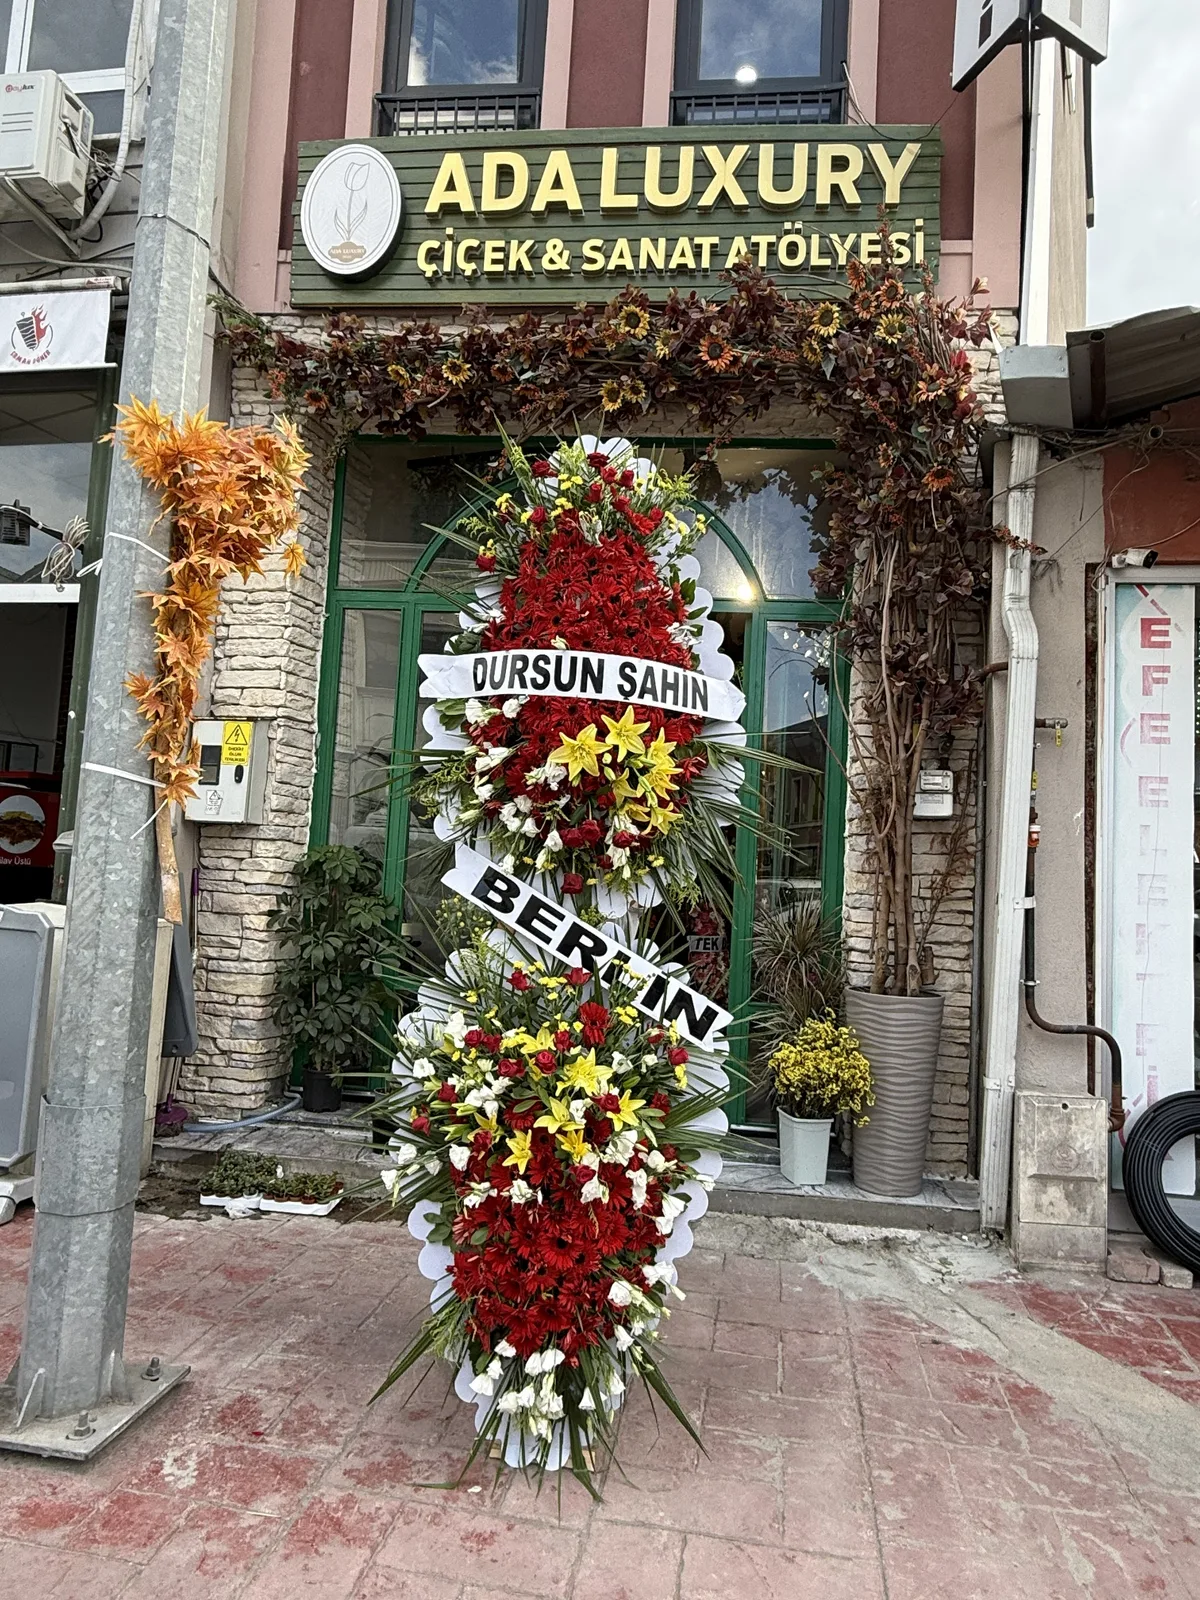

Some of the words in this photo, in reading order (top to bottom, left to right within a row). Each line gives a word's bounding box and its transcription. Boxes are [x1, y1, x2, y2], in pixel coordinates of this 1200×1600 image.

[424, 149, 584, 216] ADA
[600, 143, 921, 214] LUXURY
[417, 227, 535, 278] ÇİÇEK
[541, 238, 571, 270] &
[581, 236, 720, 271] SANAT
[724, 219, 924, 270] ATÖLYESİ
[473, 654, 604, 692] DURSUN
[617, 662, 708, 712] ŞAHİN
[1140, 618, 1171, 744] EFE
